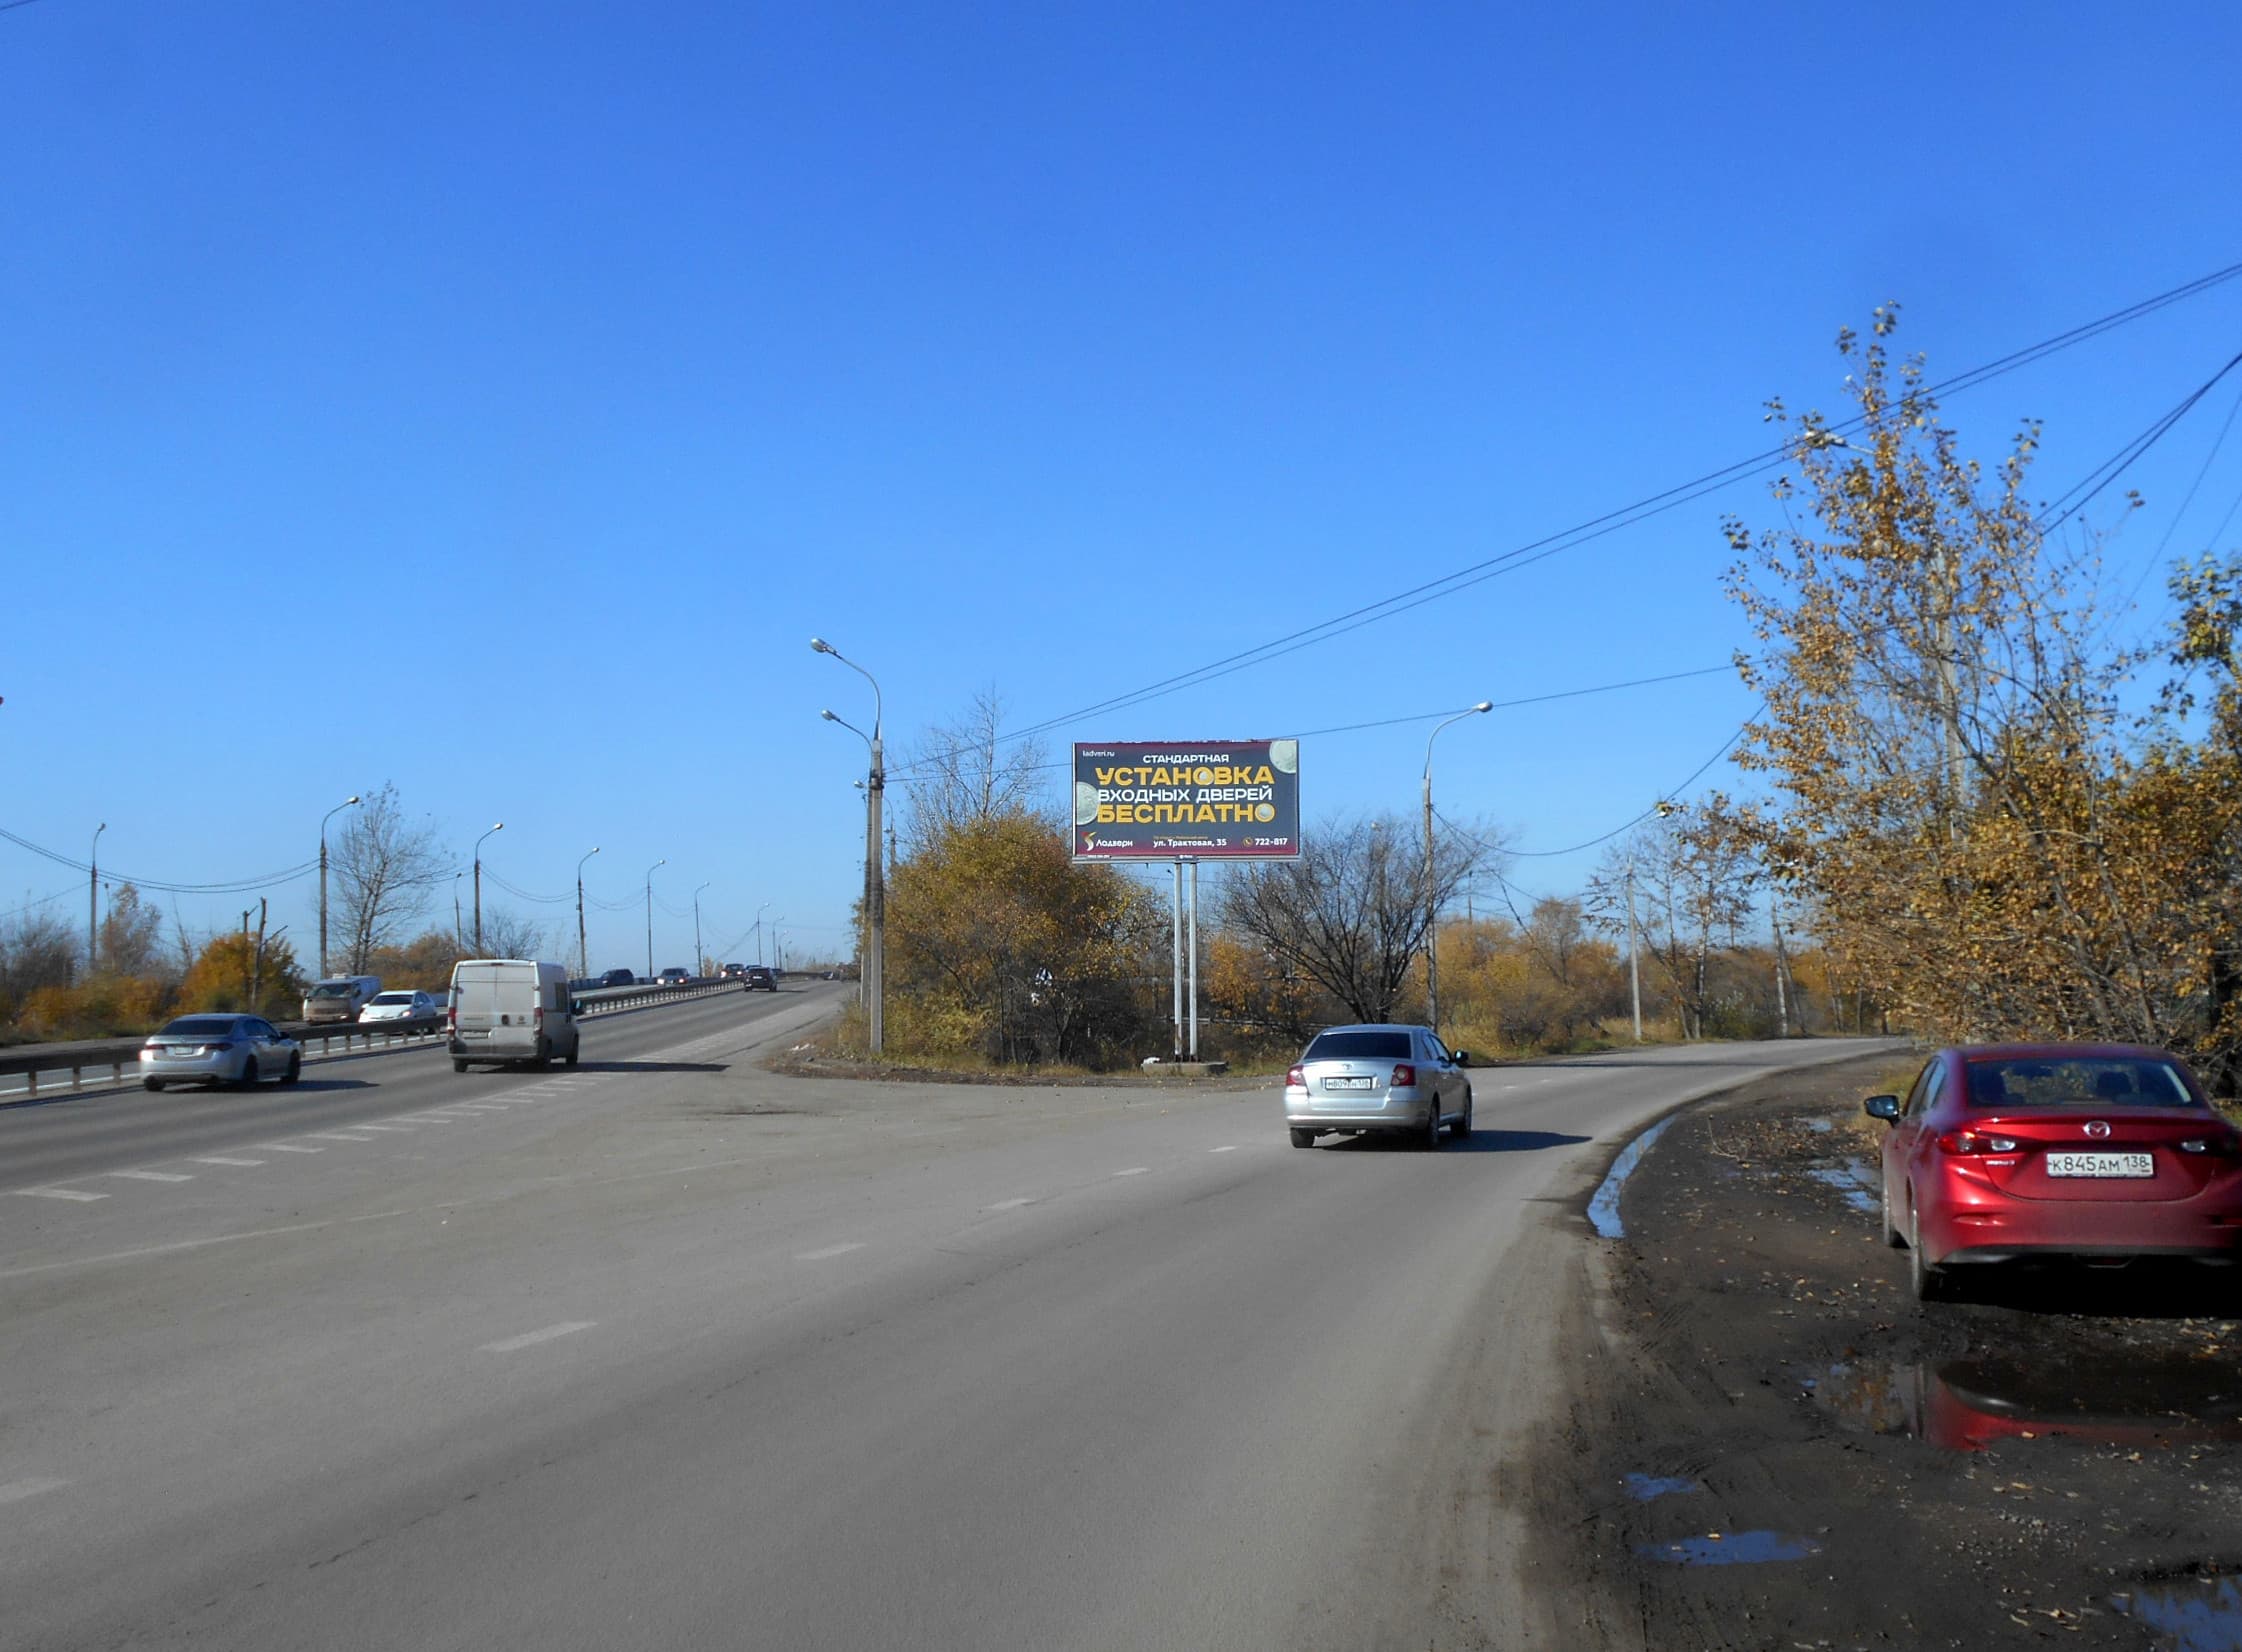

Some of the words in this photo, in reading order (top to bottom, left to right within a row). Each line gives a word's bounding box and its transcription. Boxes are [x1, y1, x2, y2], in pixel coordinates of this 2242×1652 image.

[1142, 754, 1229, 764] СТАНДАРТНАЯ
[1095, 766, 1275, 786] УСТАНОВКА
[1098, 788, 1190, 803] ВХОДНЫХ
[1196, 785, 1273, 803] ДВЕРЕЙ
[1097, 803, 1276, 824] БЕСПЛАТНО
[1153, 840, 1166, 848] ул.
[1167, 839, 1215, 848] Трактовая,
[1216, 838, 1227, 846] 35
[1254, 838, 1288, 846] 722-817
[2053, 1156, 2120, 1172] К845АМ
[2123, 1156, 2148, 1168] 138
